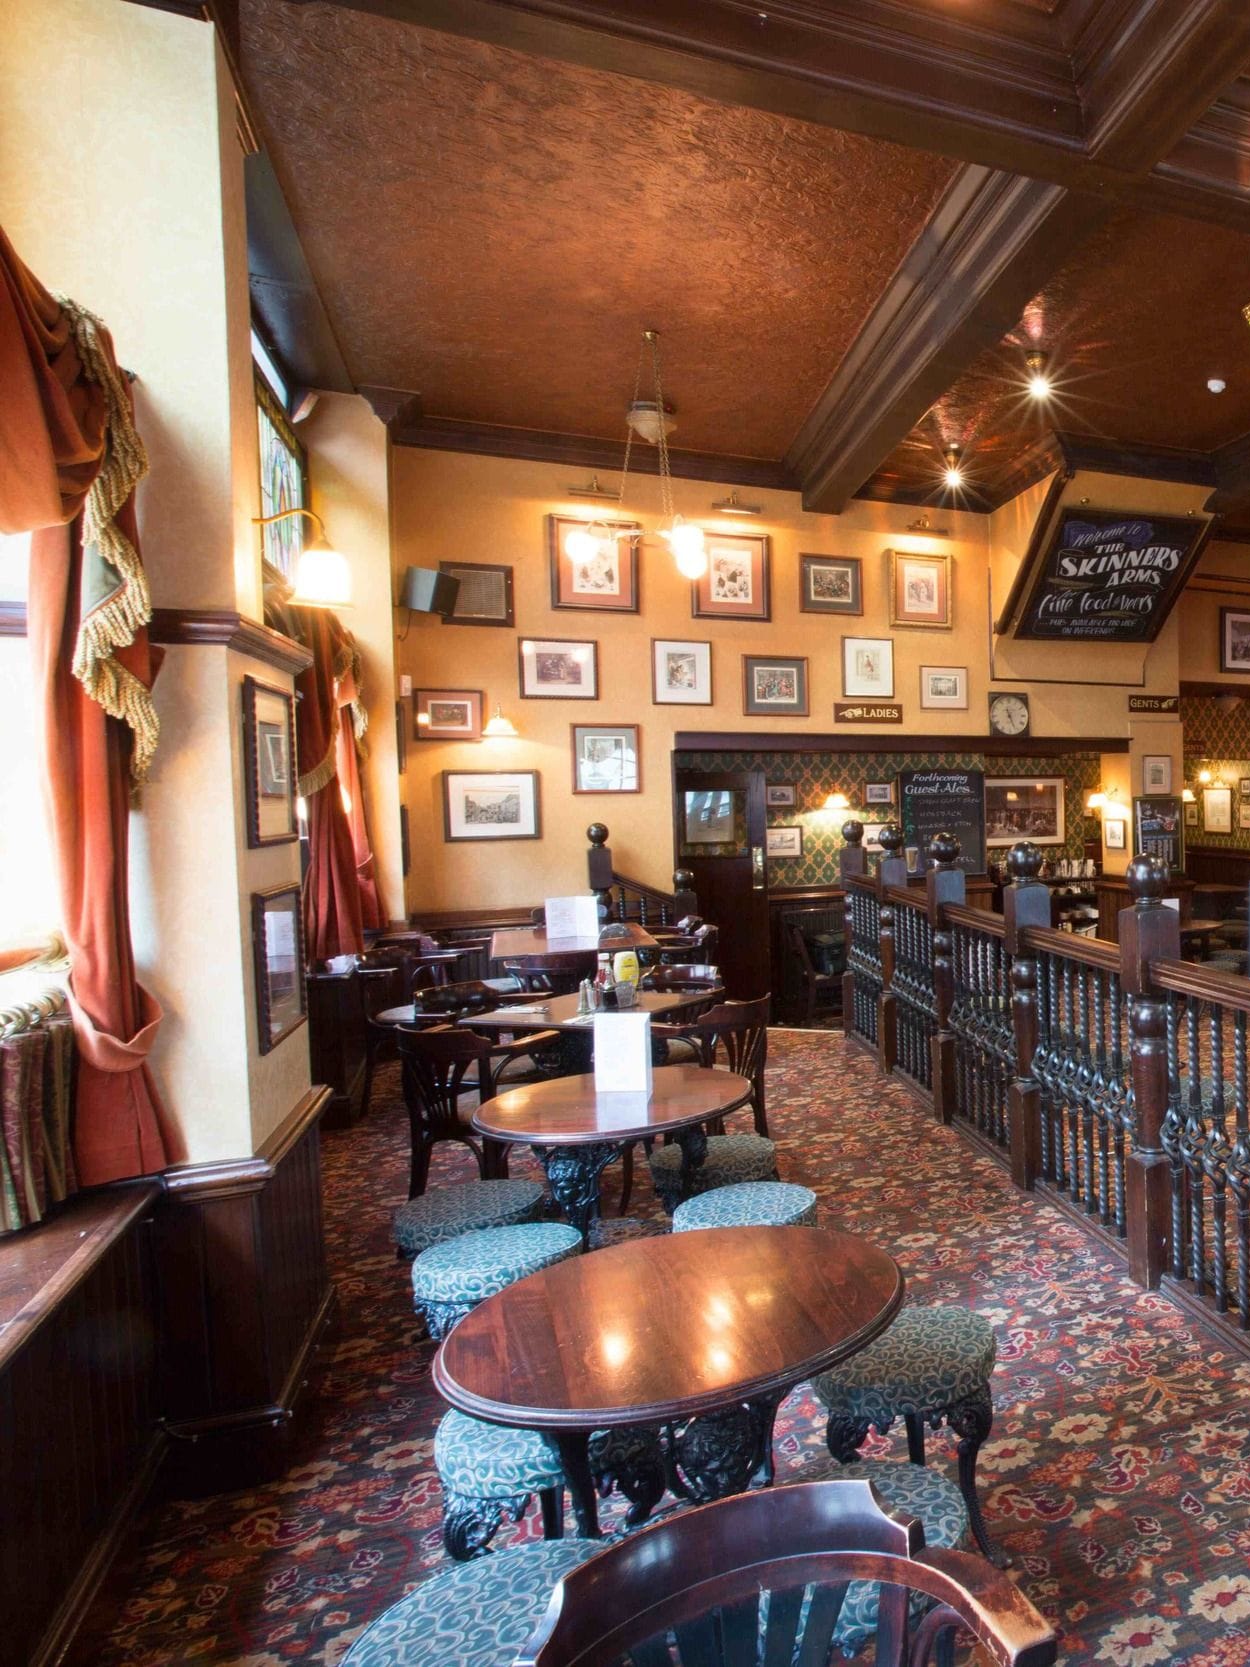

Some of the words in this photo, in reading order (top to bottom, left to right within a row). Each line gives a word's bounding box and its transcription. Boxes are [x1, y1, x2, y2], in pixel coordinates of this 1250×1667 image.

[1095, 542, 1125, 554] THE
[1060, 546, 1182, 577] SKINNERS
[1105, 568, 1161, 588] ARMS
[1130, 698, 1160, 709] GENTS
[863, 707, 899, 718] LADIES
[912, 772, 968, 784] Forthcoming
[904, 782, 939, 795] Guest
